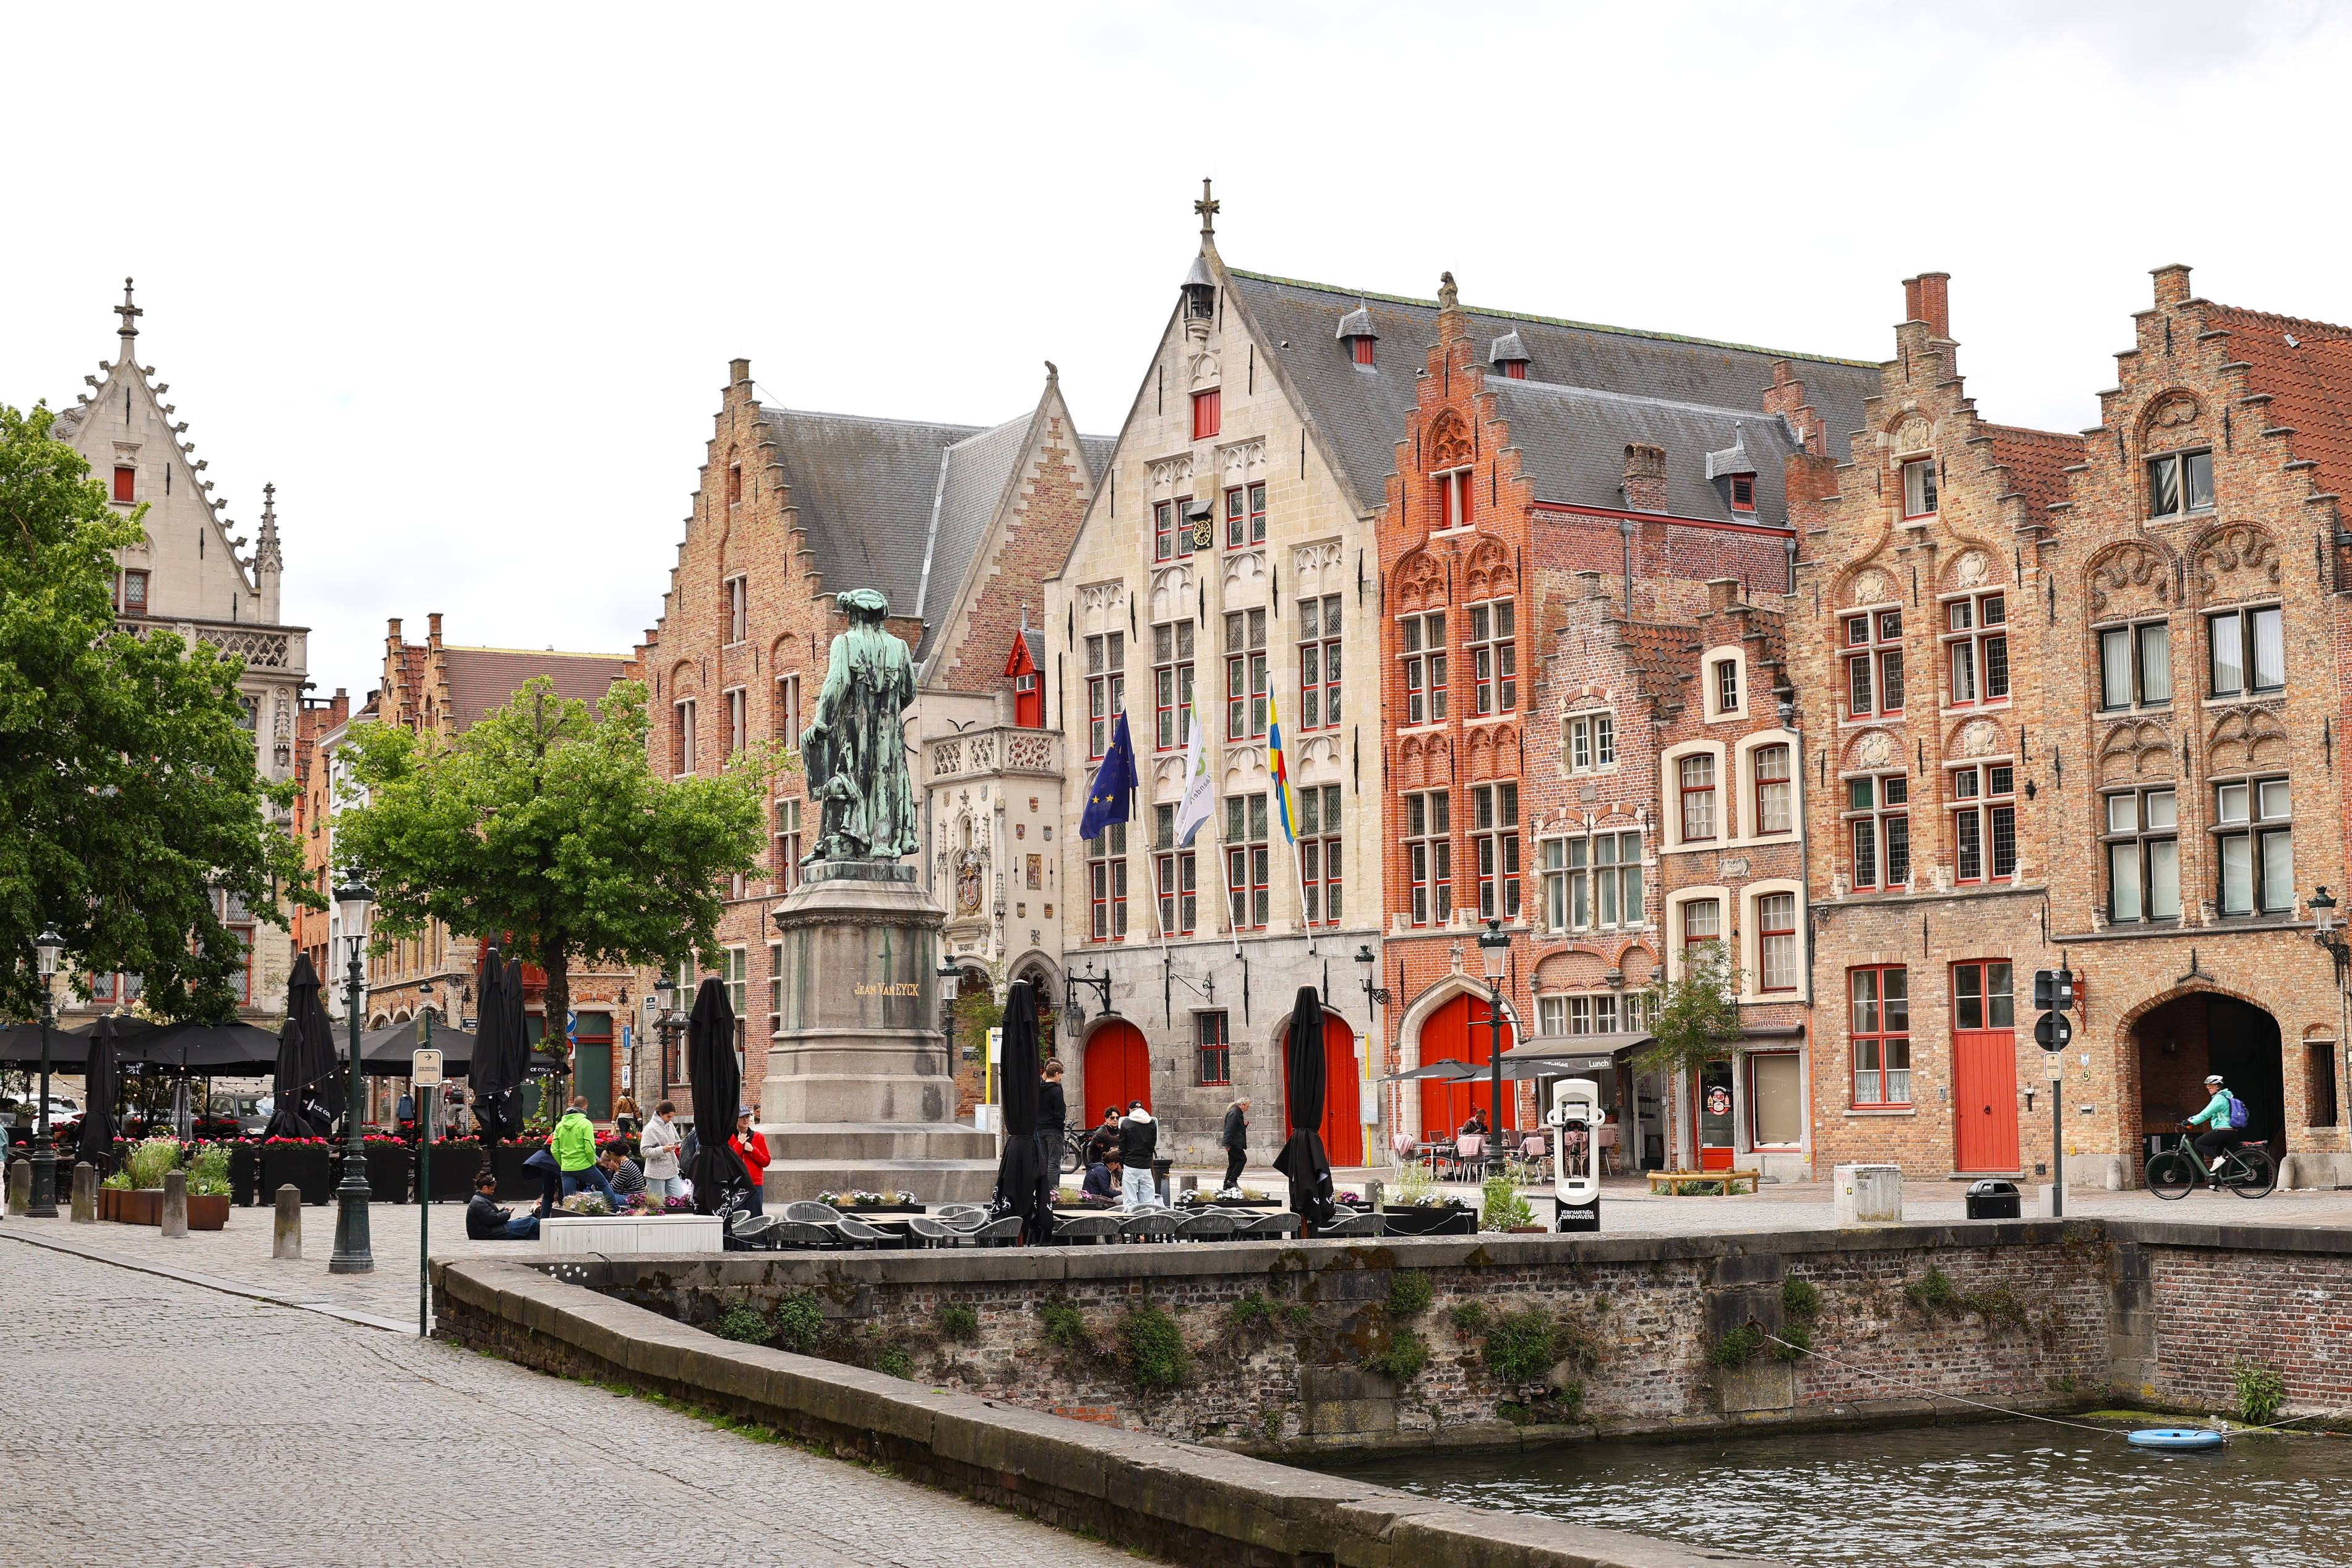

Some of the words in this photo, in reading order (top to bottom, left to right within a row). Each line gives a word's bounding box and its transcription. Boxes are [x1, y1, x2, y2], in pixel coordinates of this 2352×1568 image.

[896, 983, 919, 996] EYCK
[1588, 1060, 1608, 1068] Lunch
[314, 1104, 323, 1112] ICE
